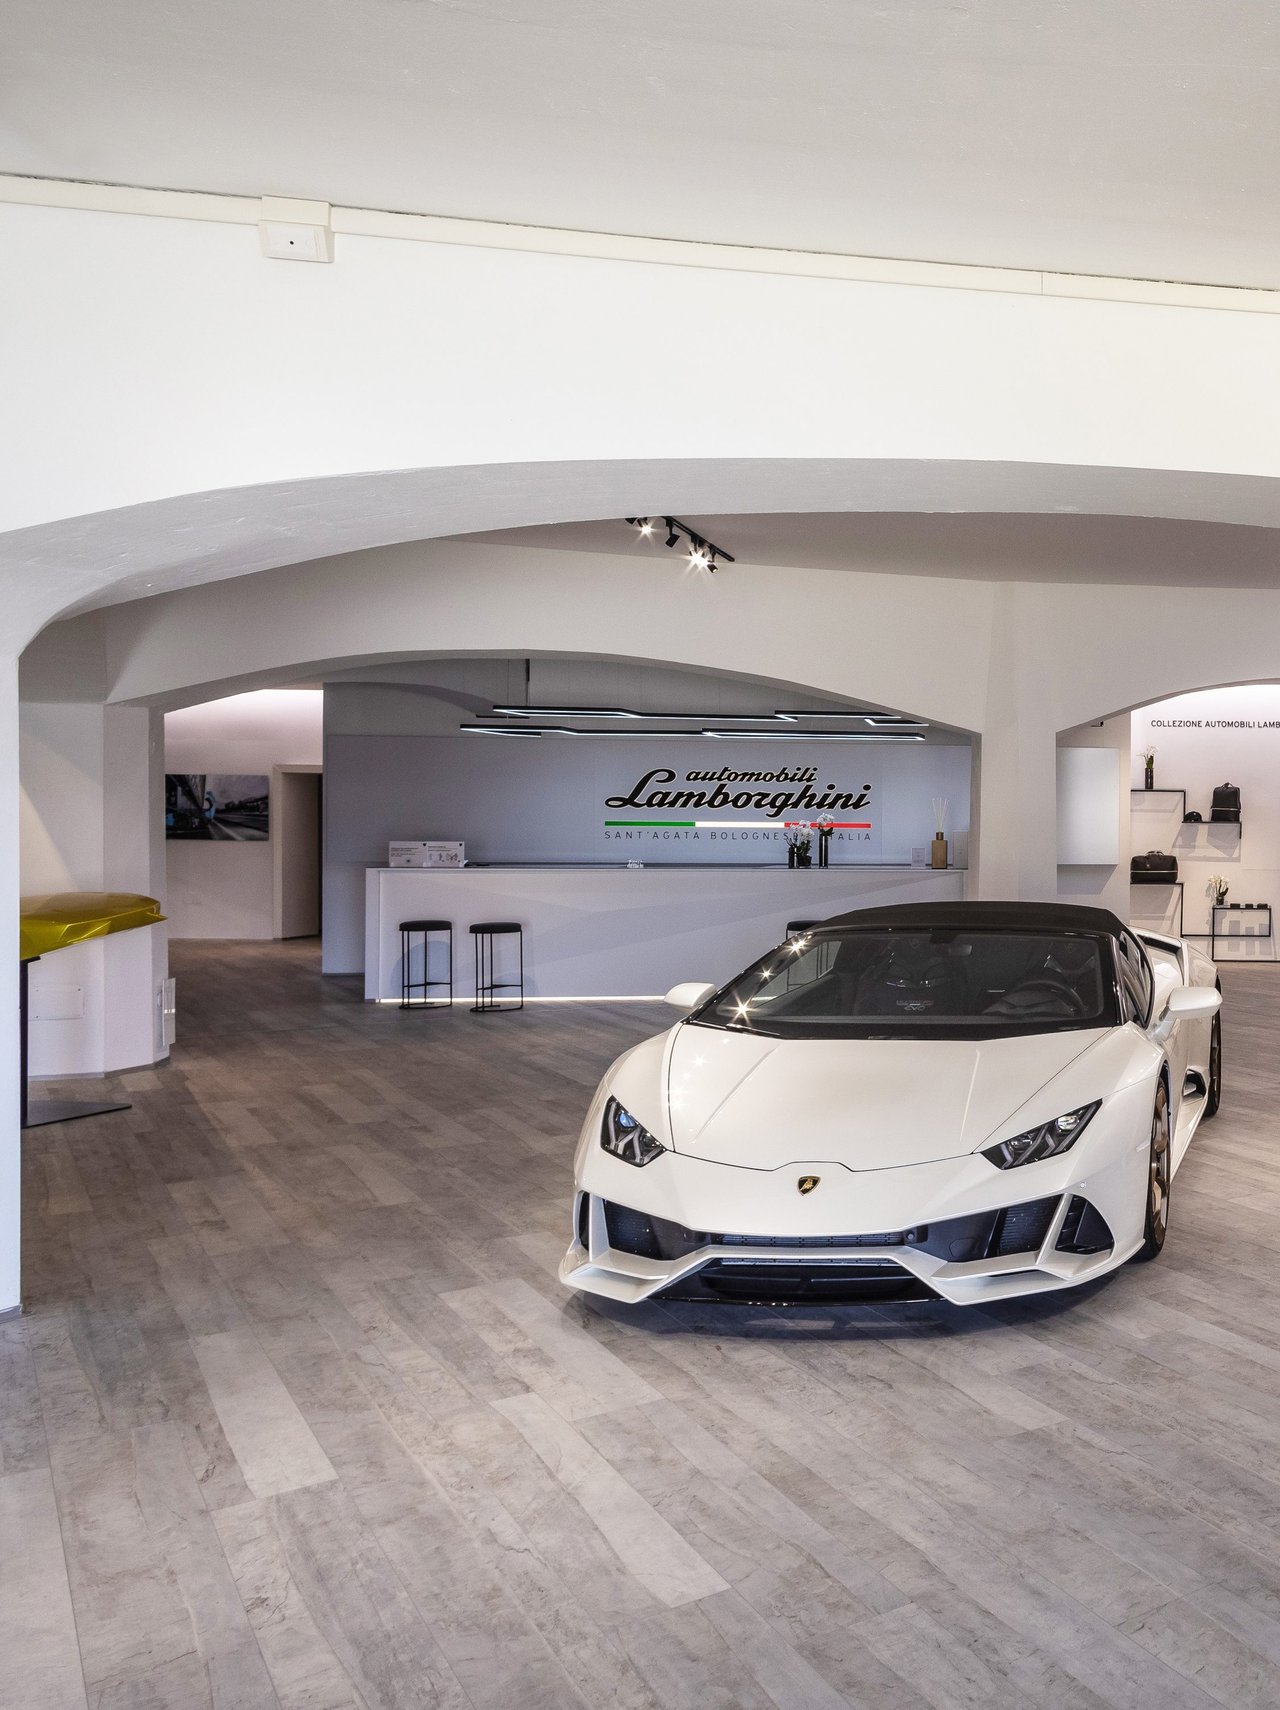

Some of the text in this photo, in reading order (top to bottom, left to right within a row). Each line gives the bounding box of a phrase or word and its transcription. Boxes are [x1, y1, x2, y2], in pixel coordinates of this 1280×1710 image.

[1150, 720, 1203, 728] COLLEZIONE
[1205, 720, 1255, 729] AUTOMOBILI
[685, 766, 818, 783] automobili
[604, 767, 873, 818] Lamborghini
[604, 830, 700, 840] SANT'AGATA
